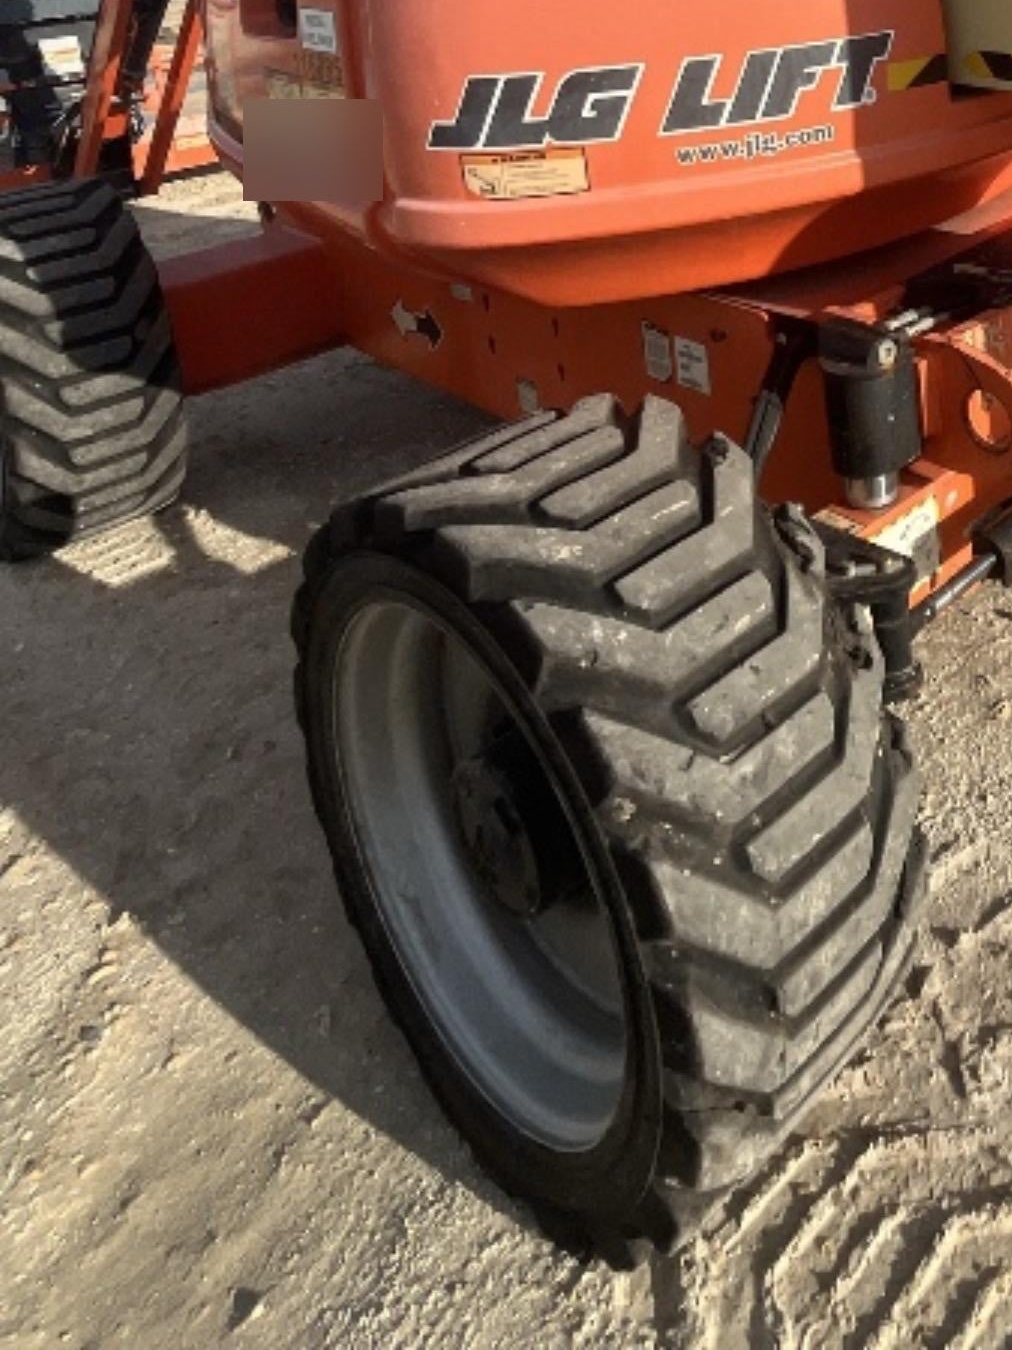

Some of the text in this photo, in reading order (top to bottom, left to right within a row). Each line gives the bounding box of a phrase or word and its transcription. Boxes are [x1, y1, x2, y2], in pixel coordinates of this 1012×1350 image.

[427, 29, 896, 150] JLG LIFT
[676, 122, 836, 165] www.jlg.com
